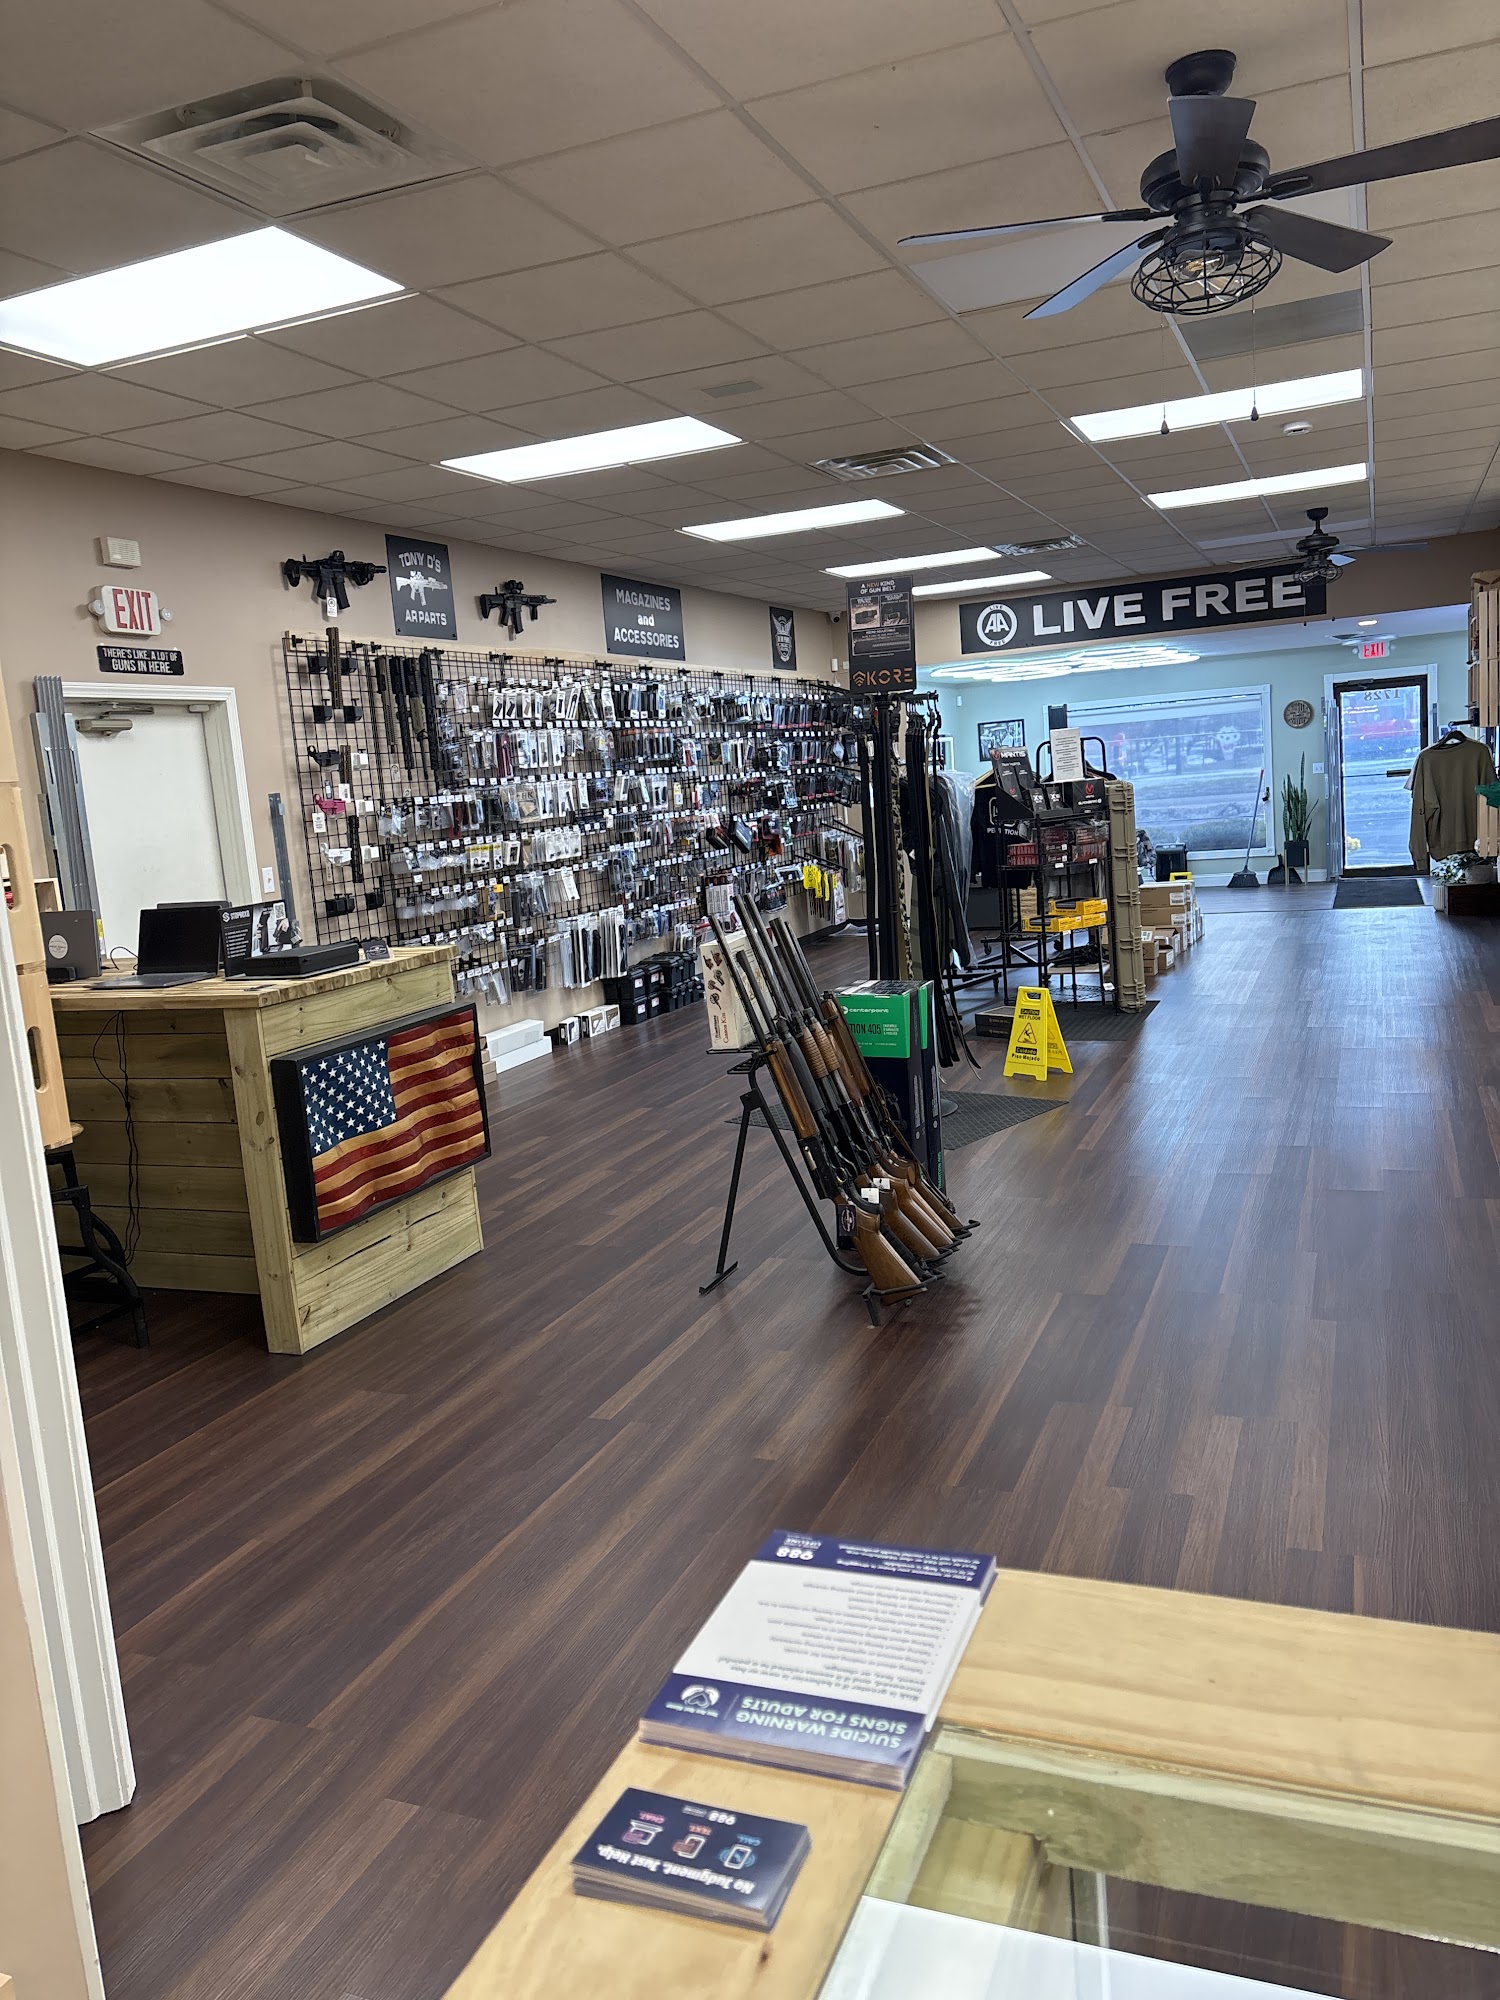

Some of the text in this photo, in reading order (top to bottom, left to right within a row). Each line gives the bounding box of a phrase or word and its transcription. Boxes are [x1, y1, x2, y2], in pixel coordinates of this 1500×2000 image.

[399, 552, 441, 573] TONY D'S
[616, 588, 670, 611] MAGAZINES
[1033, 574, 1306, 636] LIVE FREE
[112, 588, 152, 631] EXIT
[406, 609, 447, 626] AR PARTS
[638, 614, 655, 626] and
[984, 612, 1010, 633] AA
[614, 627, 679, 648] ACCESSORIES
[102, 648, 132, 658] THERE'S
[157, 652, 169, 660] LOT
[170, 652, 178, 662] OF
[1363, 642, 1384, 658] EXIT
[112, 659, 173, 673] GUNS IN HERE.
[867, 668, 913, 686] KORE
[868, 1024, 881, 1034] 405
[777, 1547, 812, 1560] 988
[743, 1698, 906, 1734] SIGNS FOR ADULTS
[737, 1712, 900, 1747] SUICIDE WARNING
[709, 1811, 735, 1824] 988
[598, 1845, 630, 1863] Help.
[631, 1854, 660, 1871] Just
[734, 1879, 754, 1894] No
